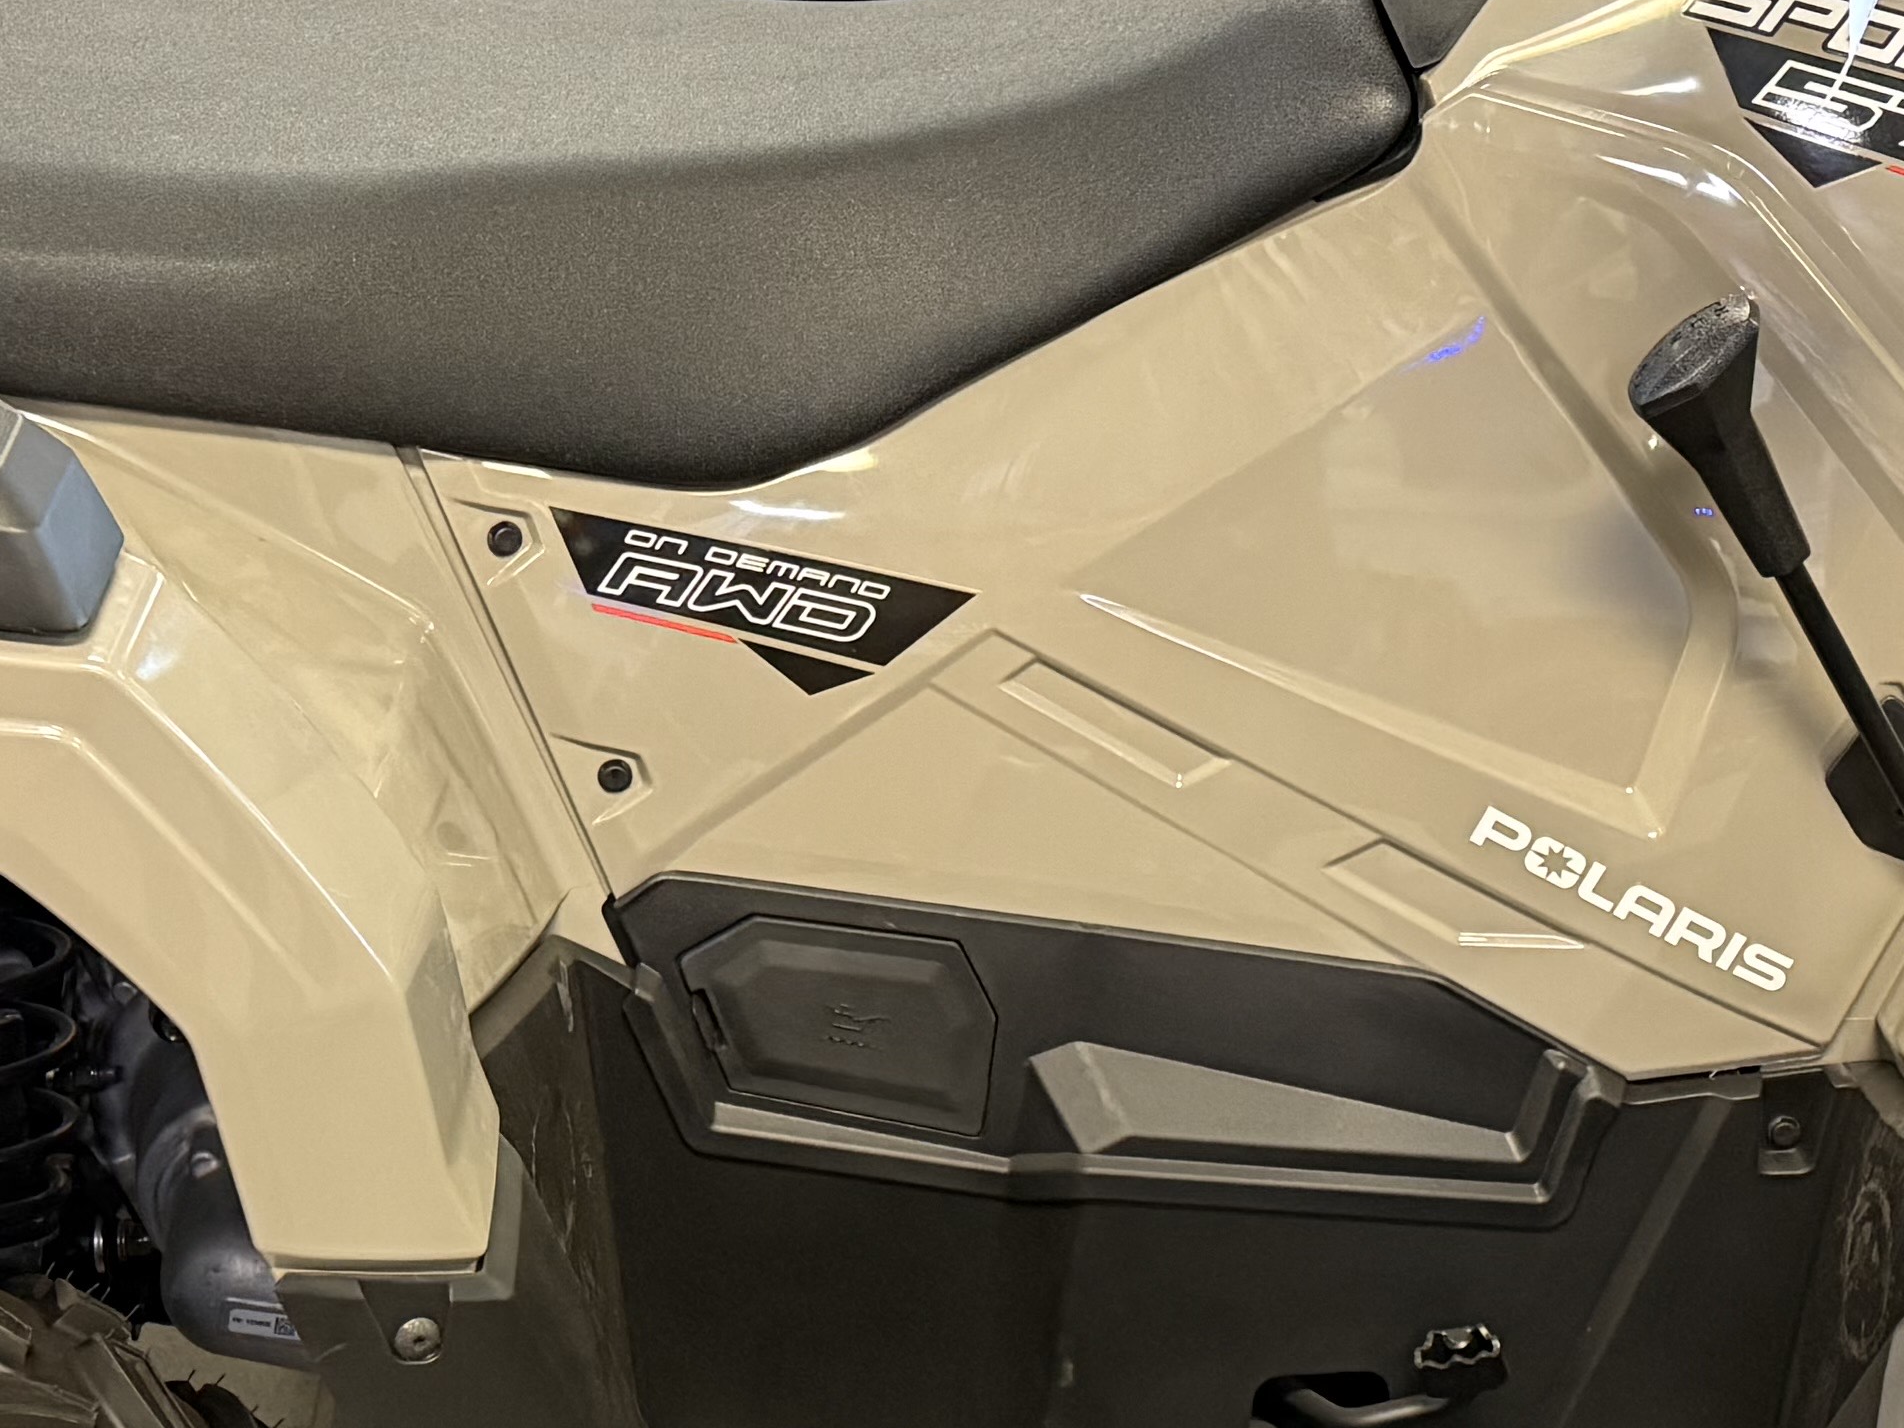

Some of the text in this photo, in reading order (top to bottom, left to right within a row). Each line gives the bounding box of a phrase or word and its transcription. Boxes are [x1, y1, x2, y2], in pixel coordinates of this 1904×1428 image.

[596, 549, 877, 643] AWD
[624, 528, 892, 600] ON DEMAND
[1469, 804, 1795, 992] POLARIS
